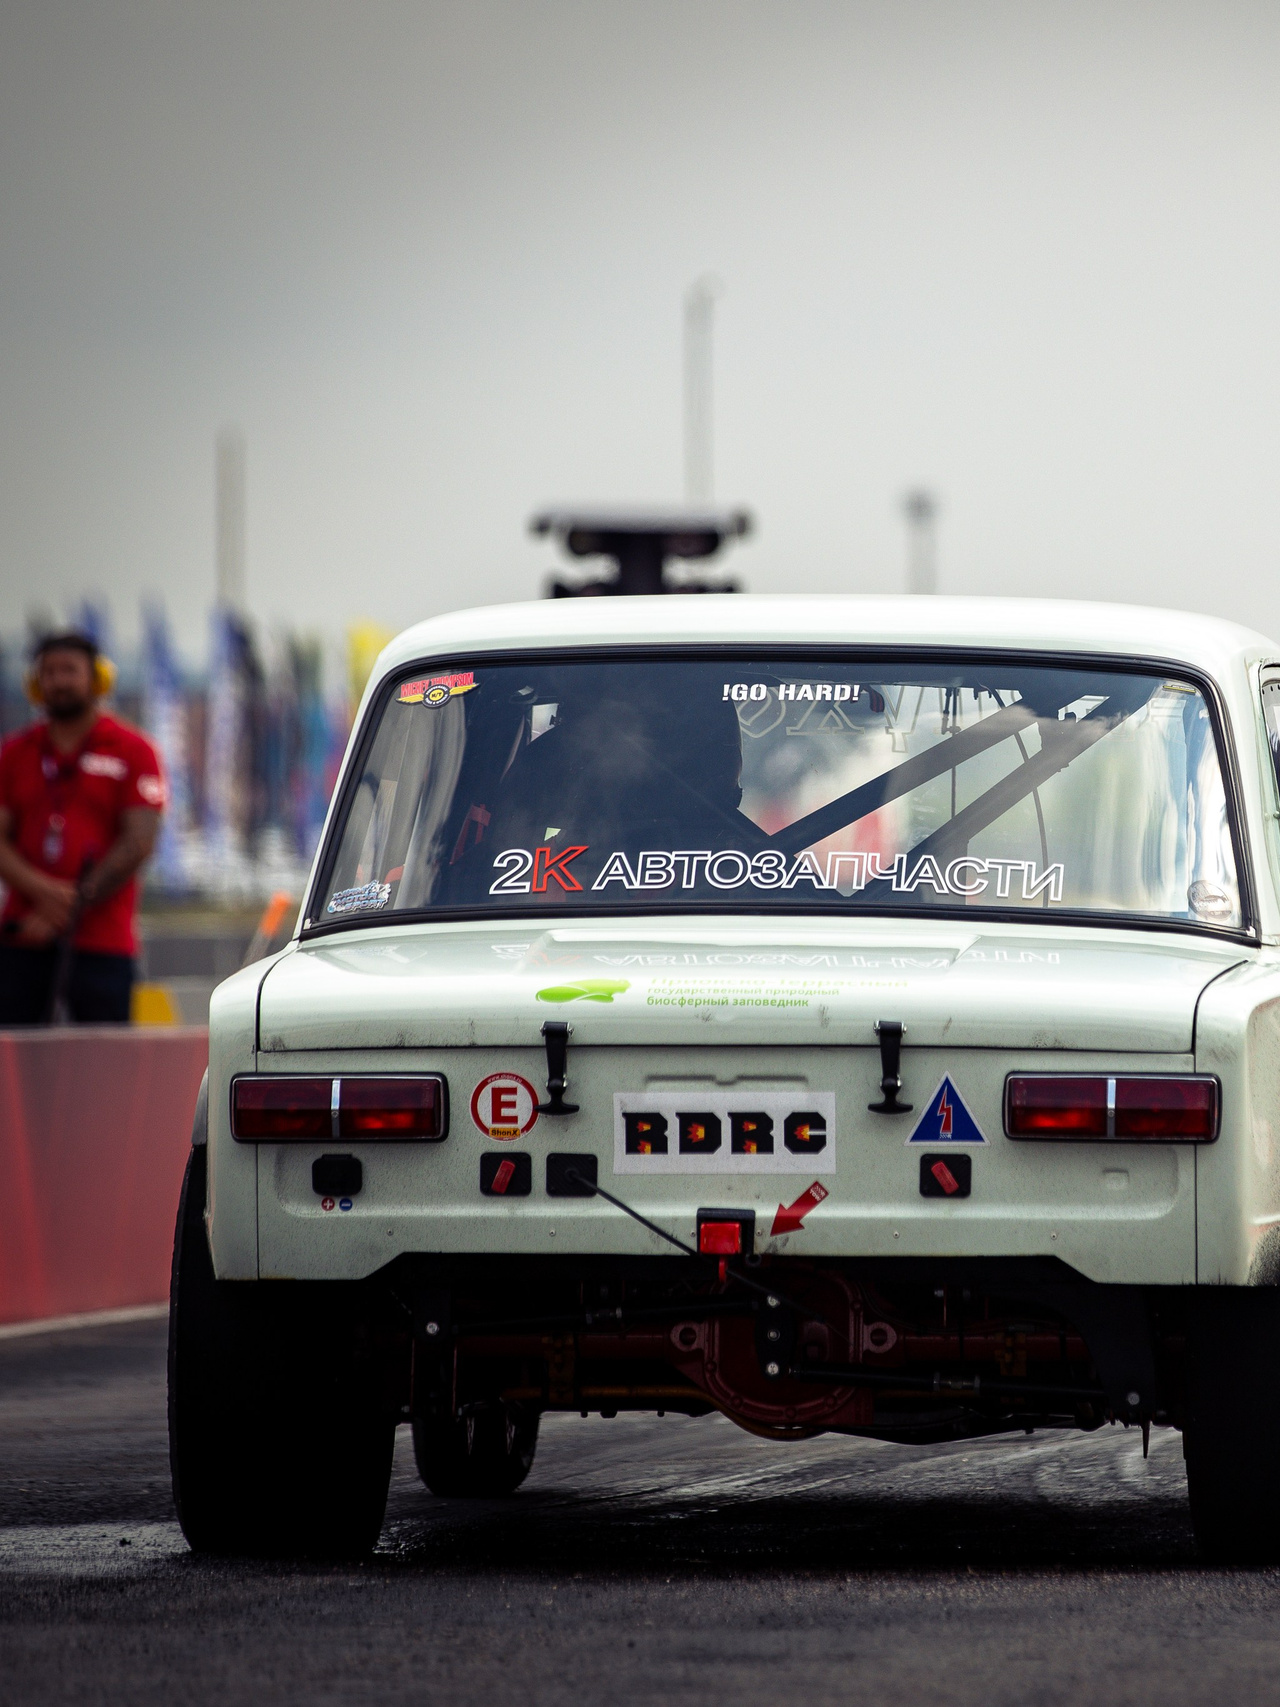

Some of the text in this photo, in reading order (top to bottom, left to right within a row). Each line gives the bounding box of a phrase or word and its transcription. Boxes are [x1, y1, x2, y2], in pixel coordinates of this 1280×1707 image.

[722, 684, 861, 701] !GO HARD!
[591, 850, 1064, 902] АВТОЗАПЧАСТИ
[646, 996, 809, 1008] биосферный заповедник
[647, 987, 840, 996] государственный природный
[491, 1086, 518, 1124] E
[622, 1112, 827, 1155] RDRC
